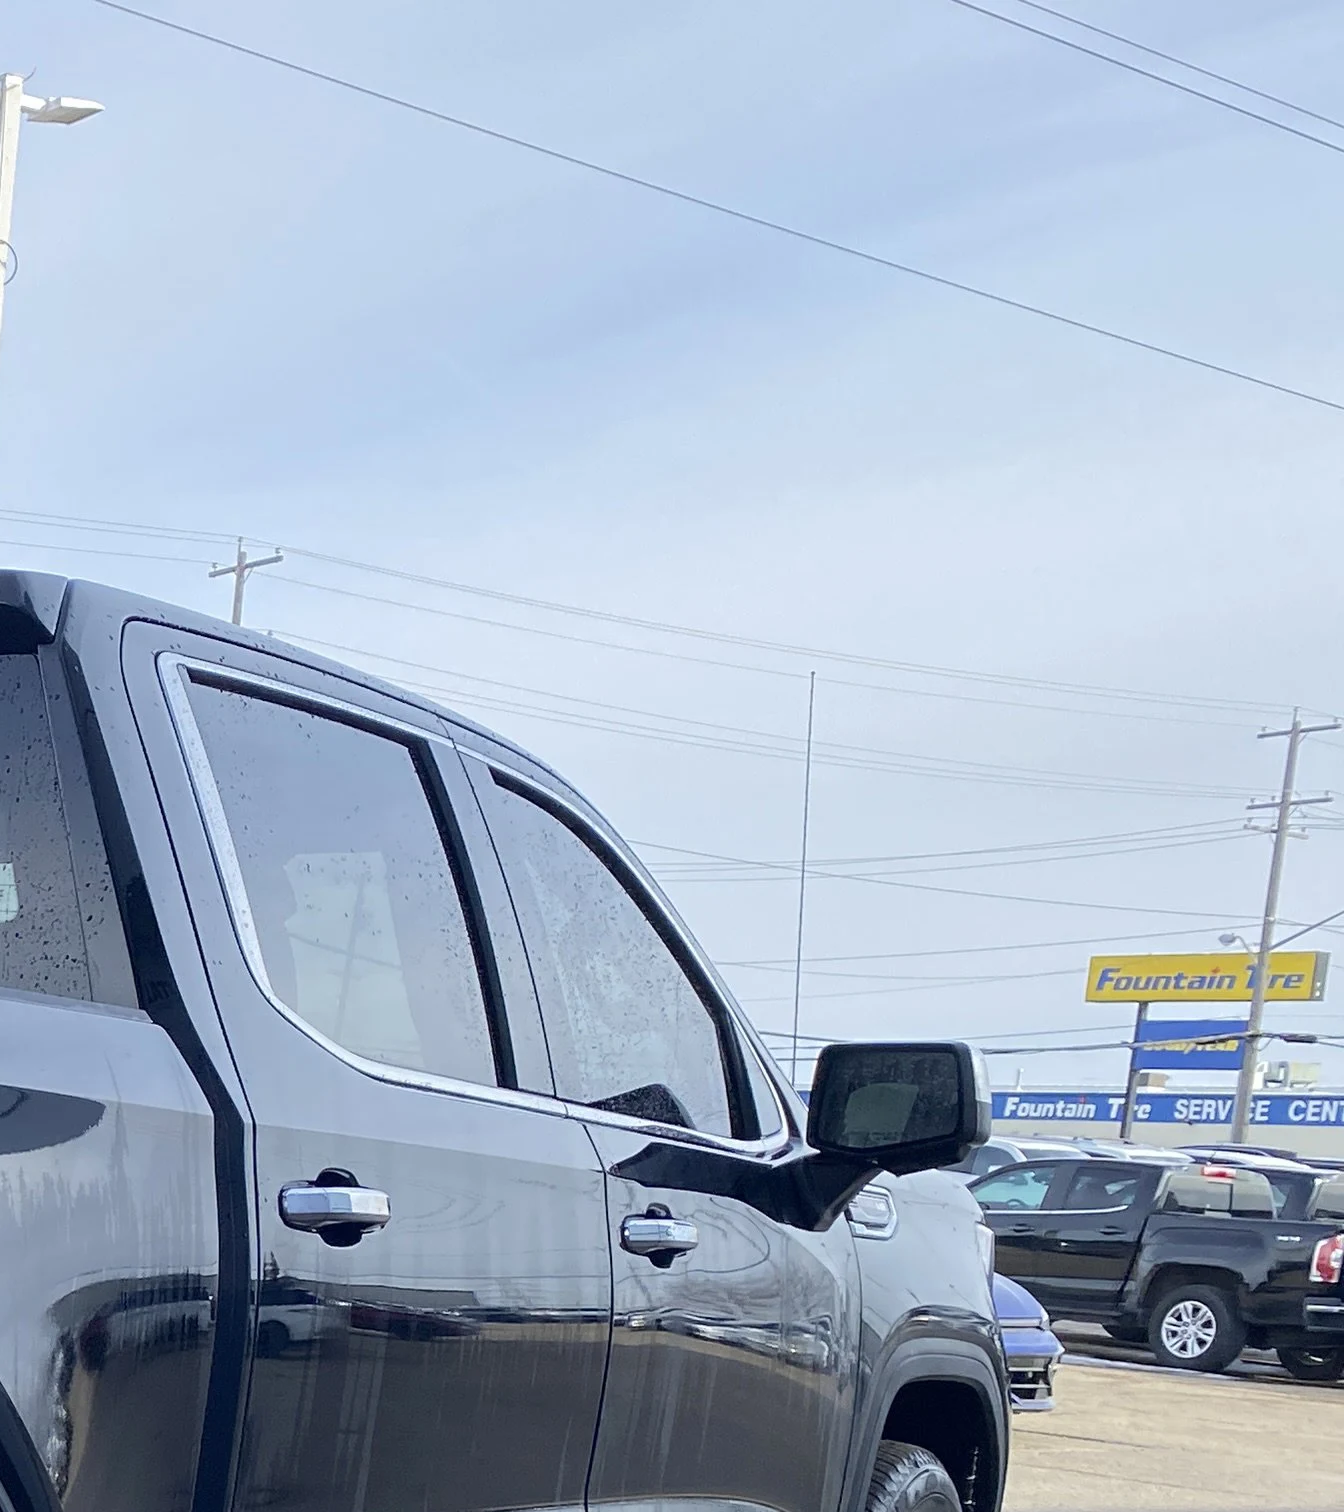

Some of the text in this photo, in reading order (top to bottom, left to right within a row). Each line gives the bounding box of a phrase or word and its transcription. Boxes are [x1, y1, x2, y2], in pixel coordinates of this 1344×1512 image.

[1095, 964, 1305, 991] Fountain Tre
[1003, 1096, 1097, 1119] Fountain
[1107, 1097, 1152, 1120] Te
[1174, 1099, 1271, 1121] SERVE
